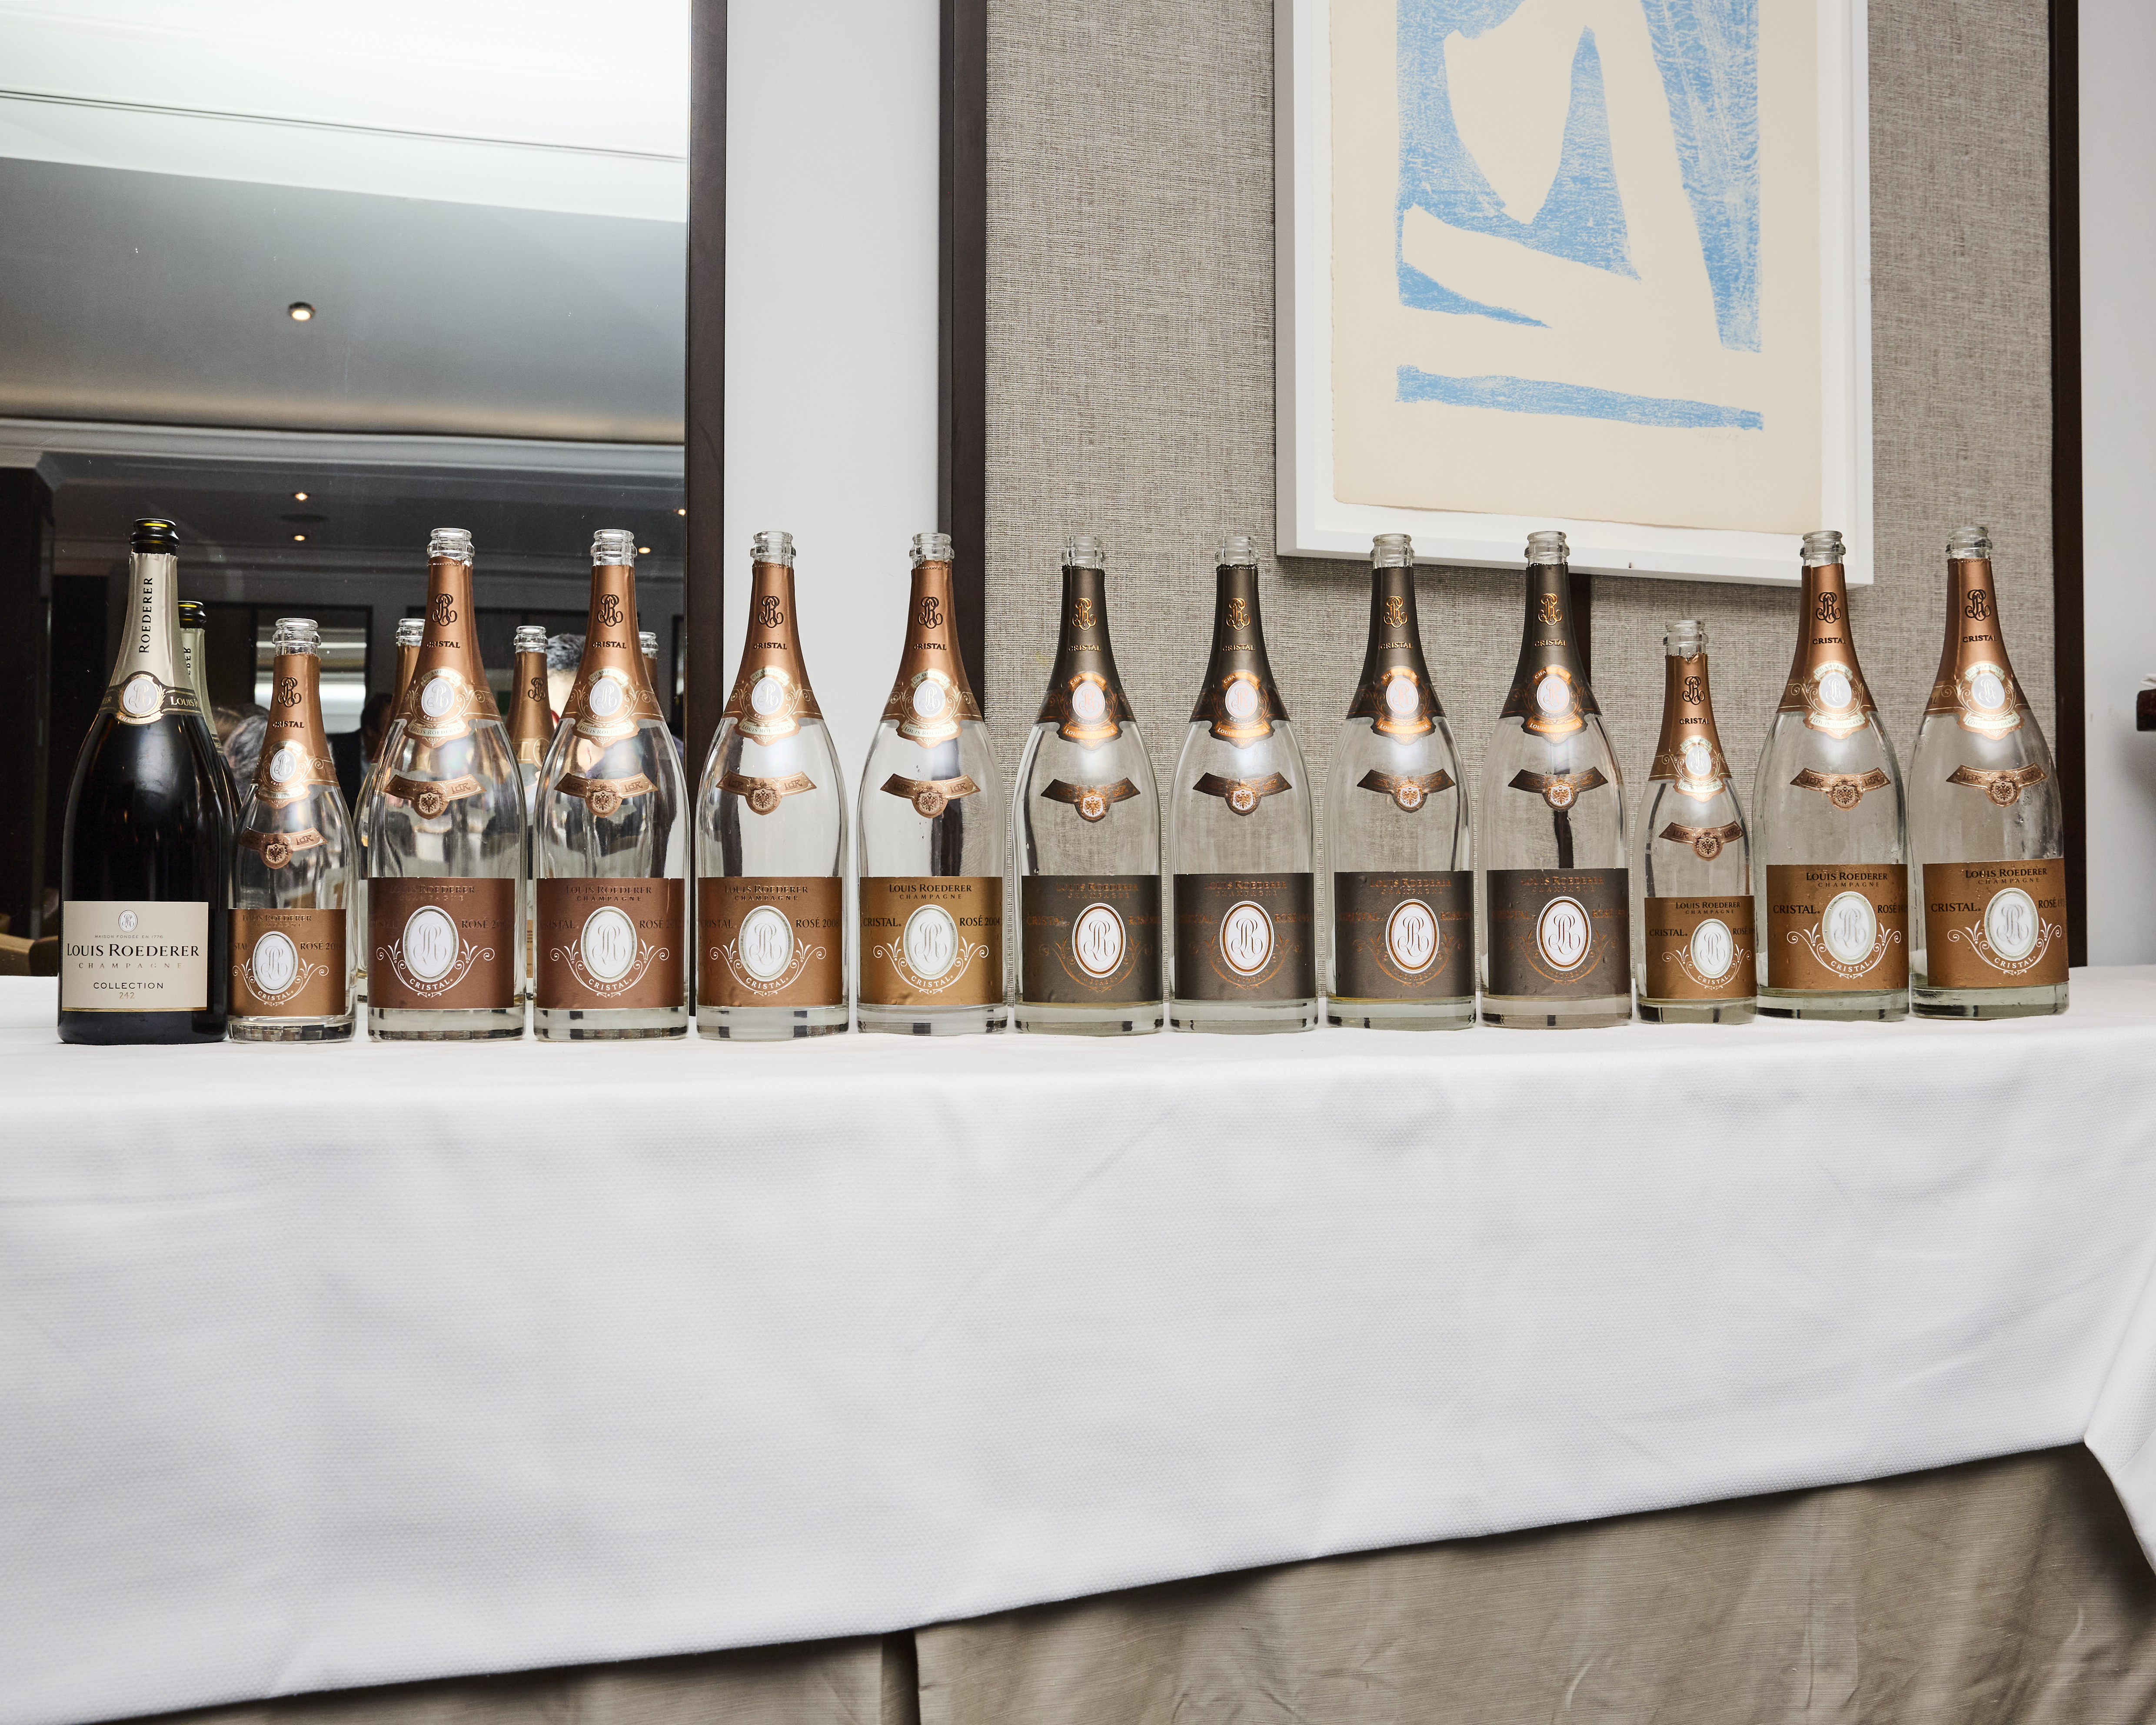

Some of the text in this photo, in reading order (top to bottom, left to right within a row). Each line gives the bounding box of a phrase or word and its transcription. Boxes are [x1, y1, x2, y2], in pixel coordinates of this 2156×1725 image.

[138, 577, 153, 654] ROEDERER
[426, 640, 460, 649] CRISTAL
[592, 641, 626, 649] CRISTAL
[170, 696, 194, 706] LOUIS
[1807, 872, 1887, 880] LOUIS ROEDERER
[1965, 868, 2047, 878] LOUIS ROEDERER
[1235, 881, 1287, 889] ROEDERER
[1370, 878, 1451, 887] LOUIS ROEDERER
[1521, 876, 1604, 885] LOUIS ROEDERER
[598, 885, 652, 894] ROEDERER
[725, 884, 808, 893] LOUIS ROEDERER
[889, 884, 972, 892] LOUIS ROEDERER
[1057, 882, 1138, 891] LOUIS ROEDERER
[1877, 902, 1896, 913] ROSÉ
[2038, 897, 2056, 909] ROSÉ
[461, 917, 488, 929] ROSÉ
[639, 917, 663, 929] ROSÉ
[796, 916, 820, 928] ROSÉ
[959, 915, 983, 926] ROSÉ
[1733, 926, 1747, 935] ROSÉ
[300, 939, 323, 950] ROSÉ
[67, 943, 200, 957] LOUIS ROEDERER
